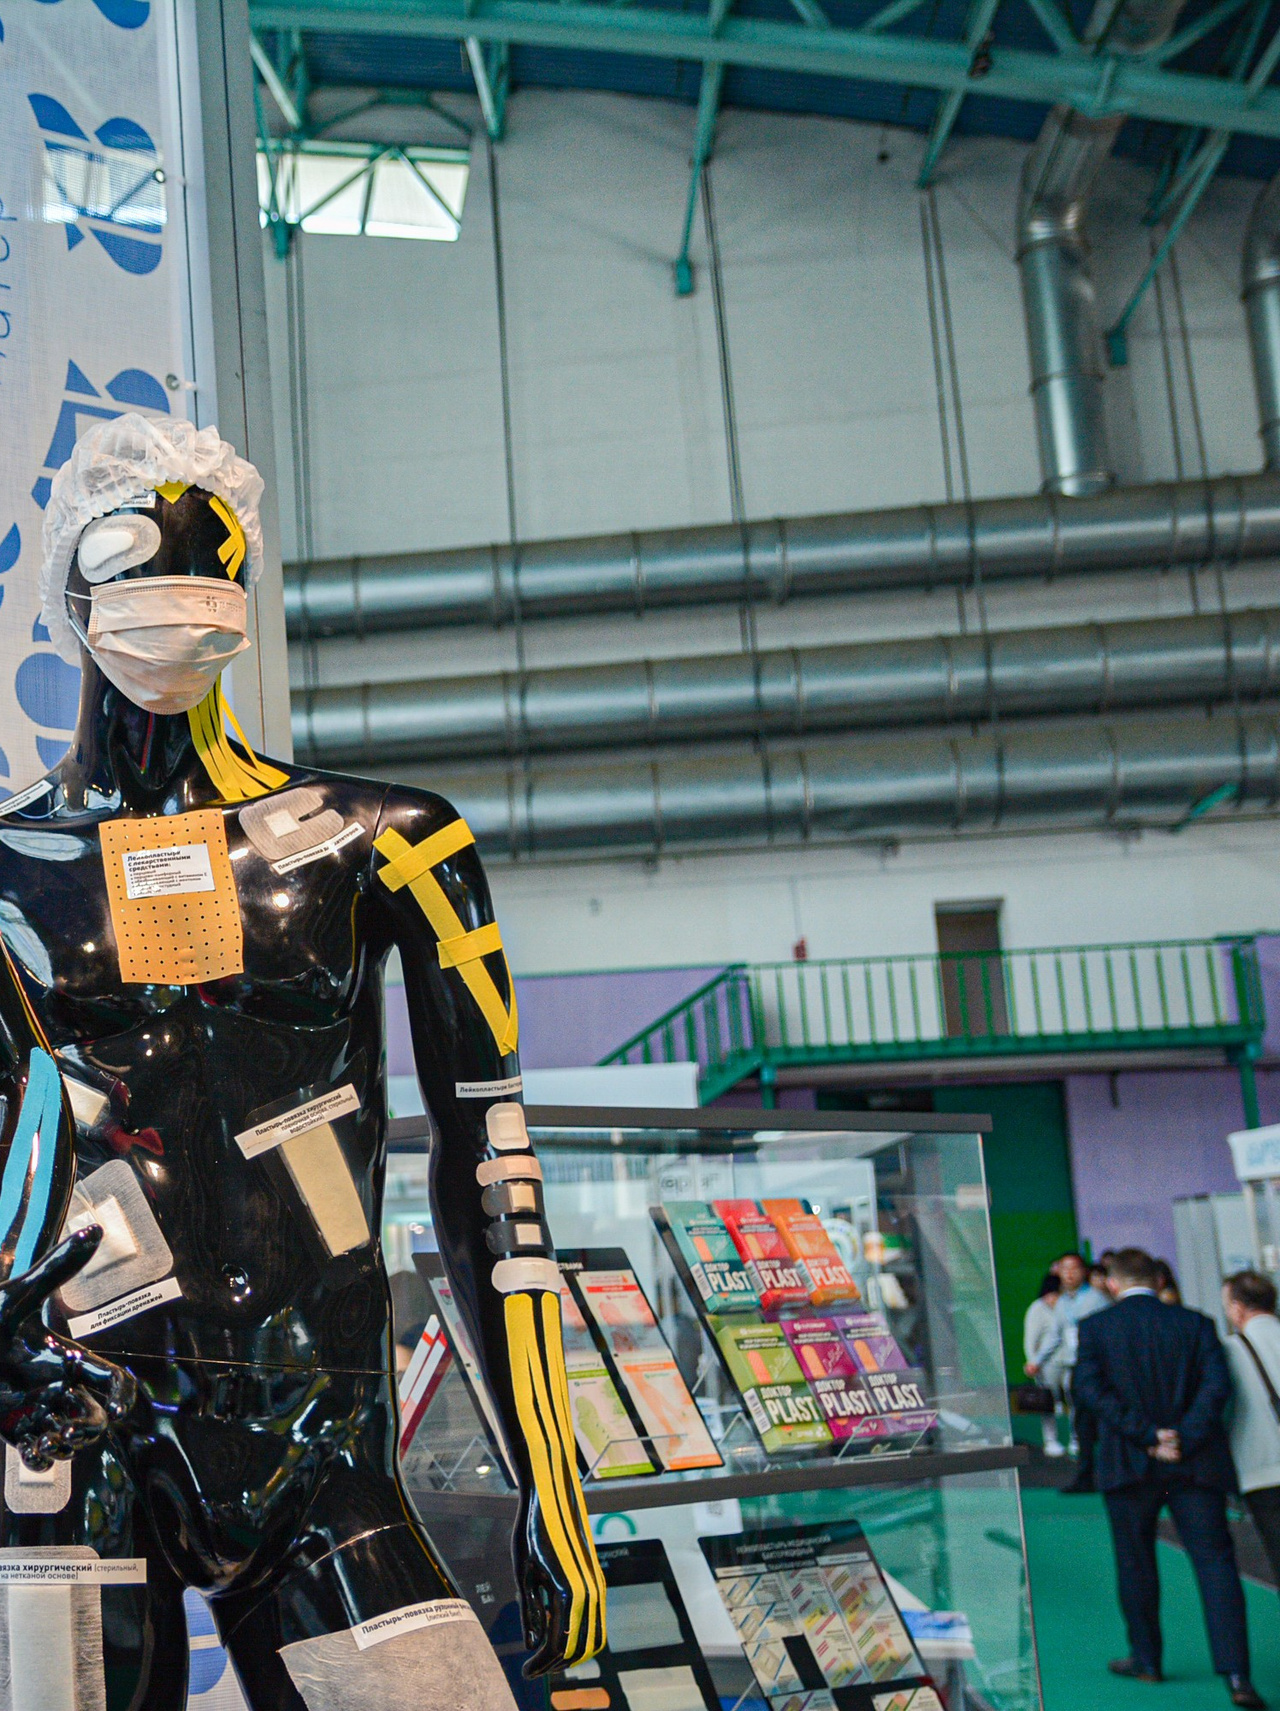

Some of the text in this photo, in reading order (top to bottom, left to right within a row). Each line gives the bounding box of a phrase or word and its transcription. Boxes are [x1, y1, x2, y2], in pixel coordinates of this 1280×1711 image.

[307, 1093, 342, 1114] хирургический
[708, 1270, 751, 1292] PLAST
[760, 1267, 802, 1289] PLAST
[810, 1265, 852, 1287] PLAST
[90, 1293, 163, 1330] для фиксации дренажей
[97, 1291, 152, 1320] Пластырь-повязка
[819, 1389, 874, 1418] PLAST
[873, 1383, 925, 1412] PLAST
[765, 1396, 820, 1425] PLAST
[10, 1572, 46, 1580] нетканой
[22, 1563, 92, 1574] хирургический
[361, 1606, 434, 1635] Пластырь-повязка
